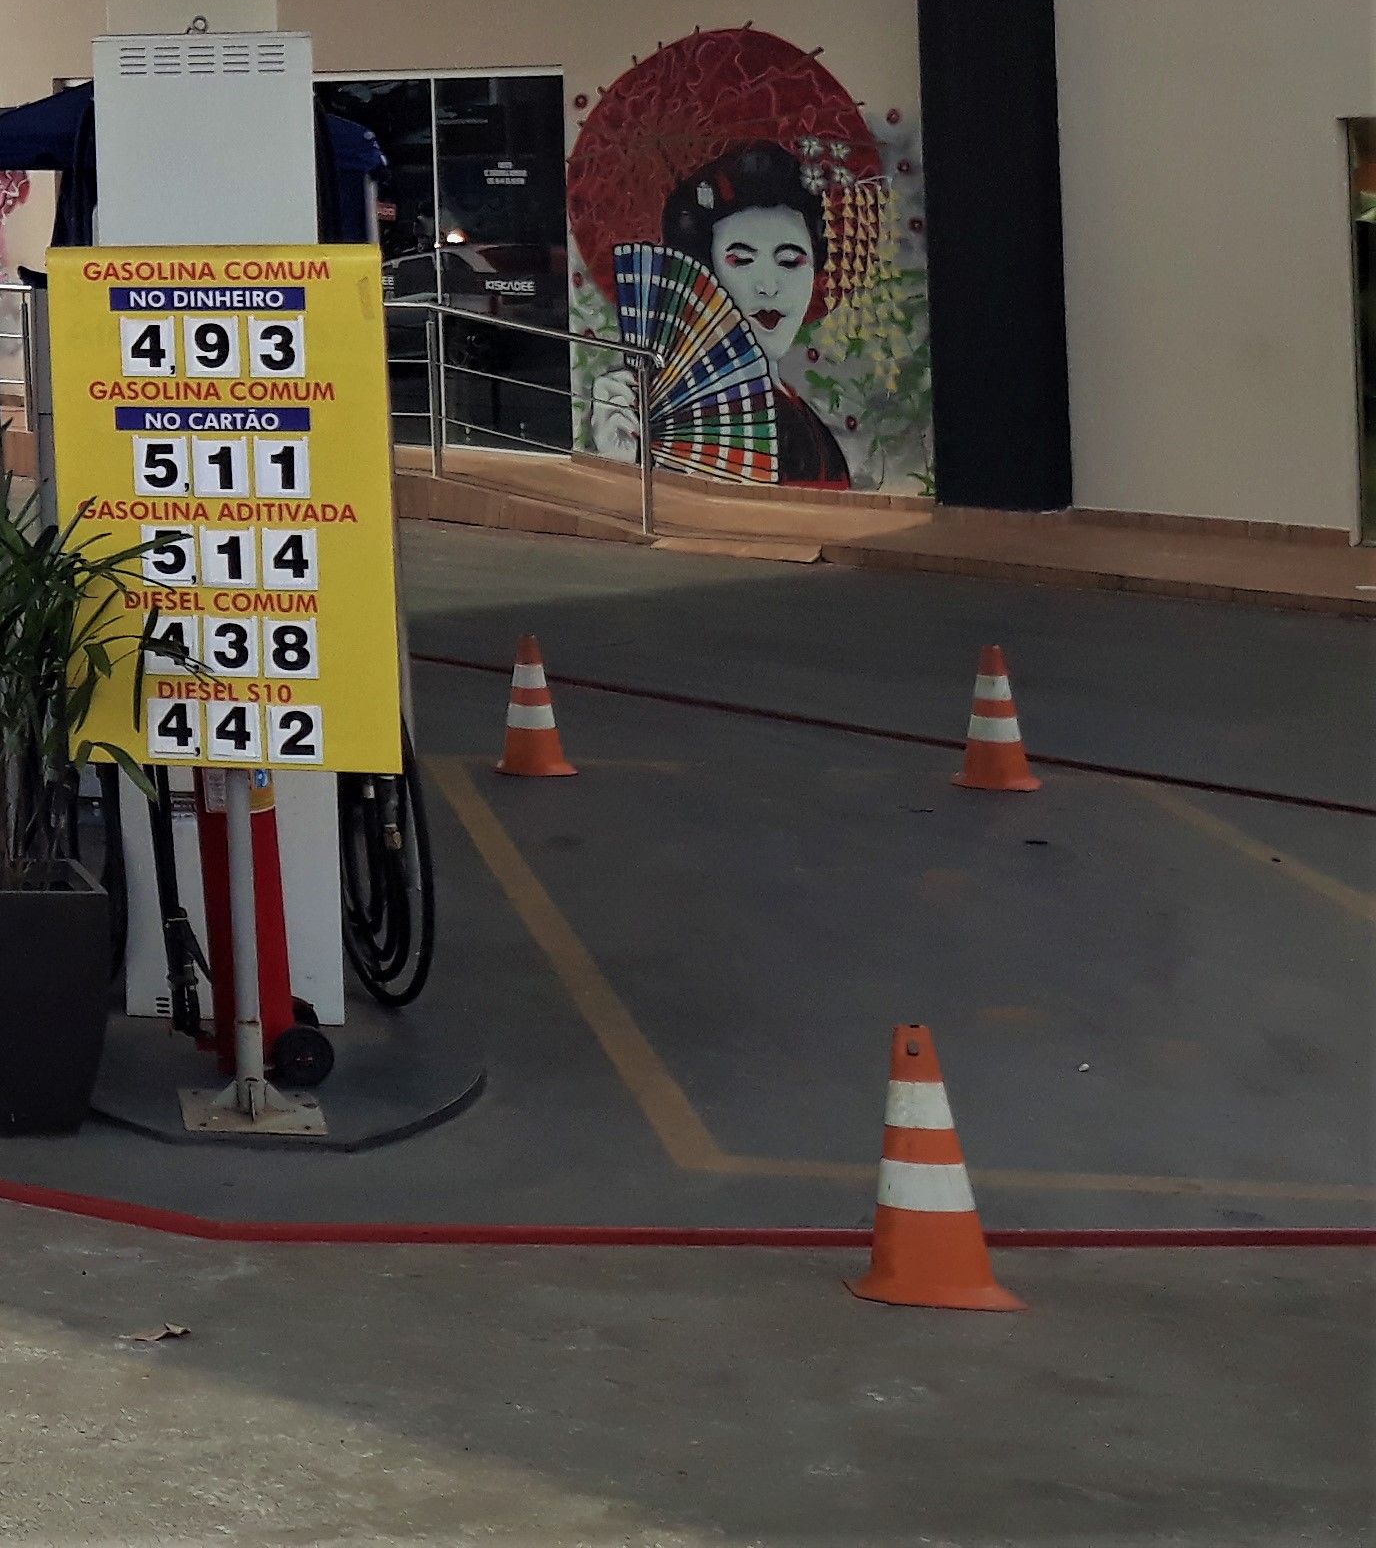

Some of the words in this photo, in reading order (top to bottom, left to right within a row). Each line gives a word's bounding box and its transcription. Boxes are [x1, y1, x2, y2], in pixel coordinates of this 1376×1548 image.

[82, 261, 216, 282] GASOLINA
[223, 261, 331, 281] COMUM
[129, 290, 166, 308] NO
[173, 289, 284, 308] DINHEIRO
[88, 381, 221, 401] GASOLINA
[229, 381, 335, 401] COMUM
[144, 413, 181, 431] NO
[188, 408, 279, 431] CARTÃO
[78, 500, 213, 522] GASOLINA
[217, 502, 358, 523] ADITIVADA
[124, 590, 205, 612] DIESEL
[213, 592, 318, 613] COMUM
[157, 681, 238, 702] DIESEL
[247, 683, 293, 703] S10
